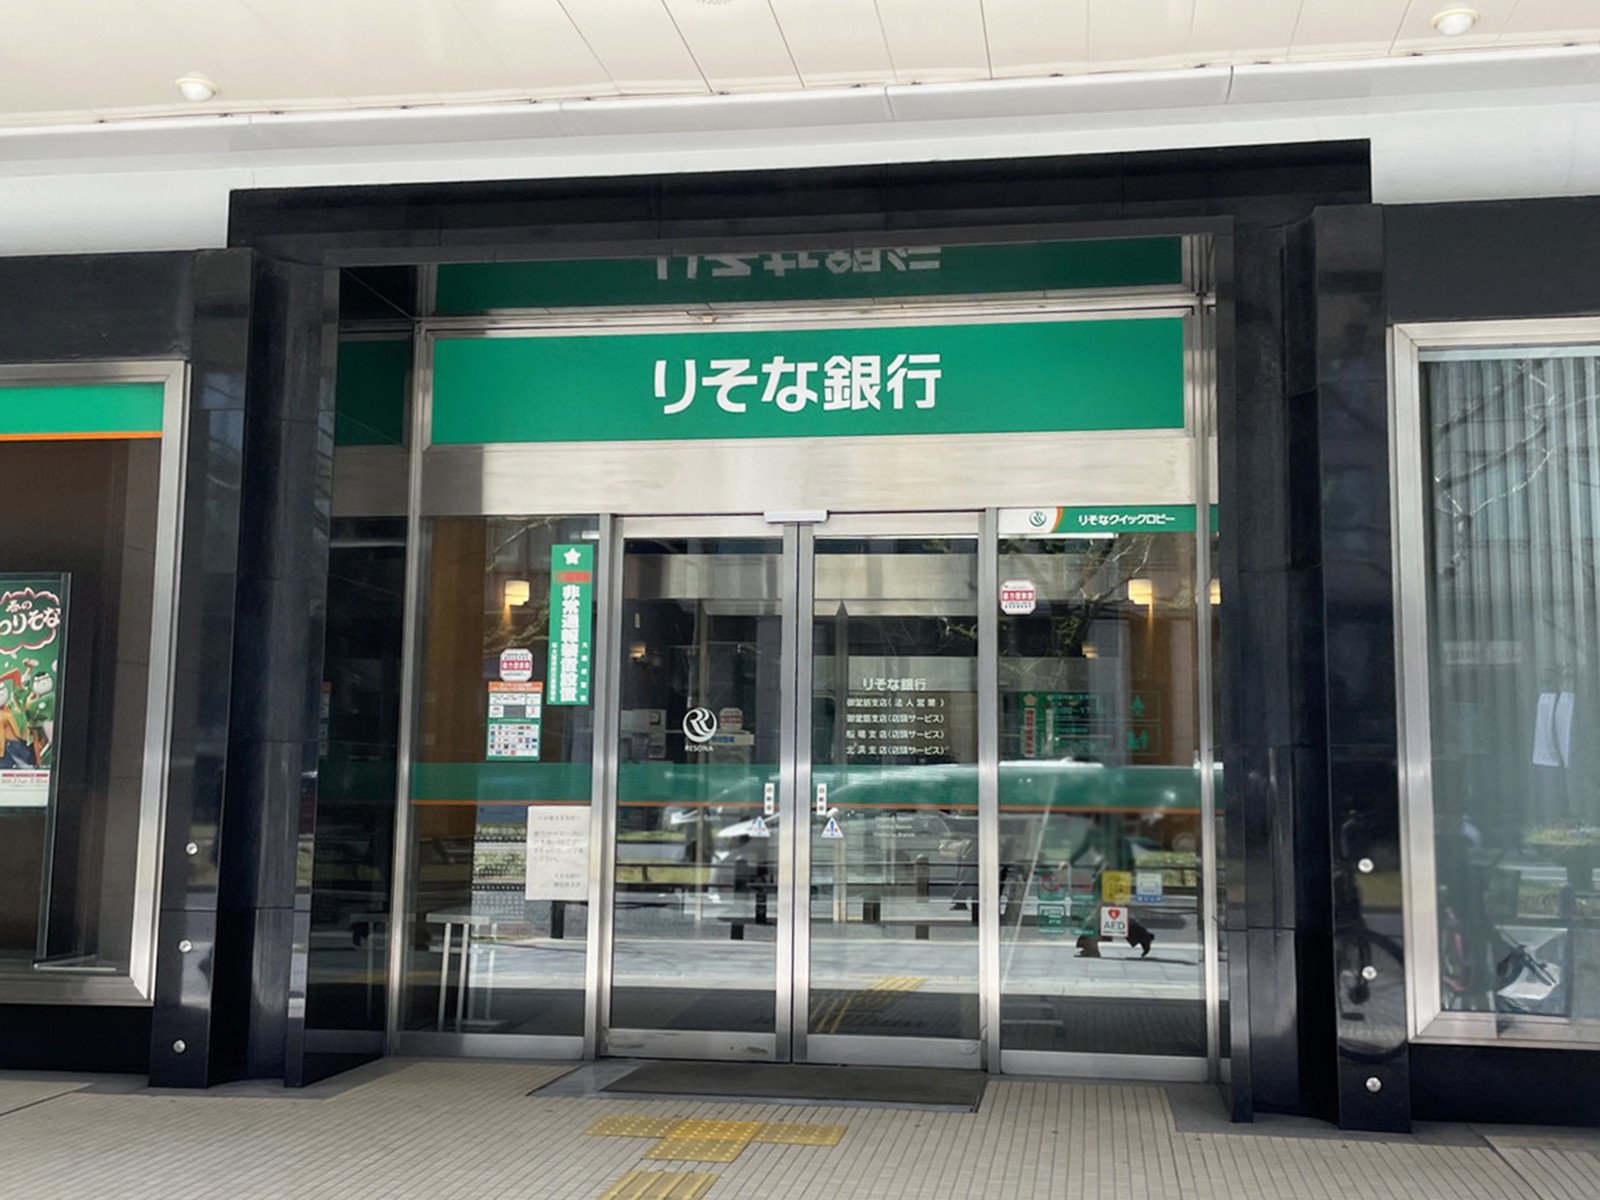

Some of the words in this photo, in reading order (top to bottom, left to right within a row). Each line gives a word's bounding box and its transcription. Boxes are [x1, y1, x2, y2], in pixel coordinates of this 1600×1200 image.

[653, 353, 942, 415] りそな銀行
[1078, 513, 1176, 526] りそなクイックロビー
[862, 678, 927, 691] りそな銀行
[1104, 921, 1126, 931] AED
